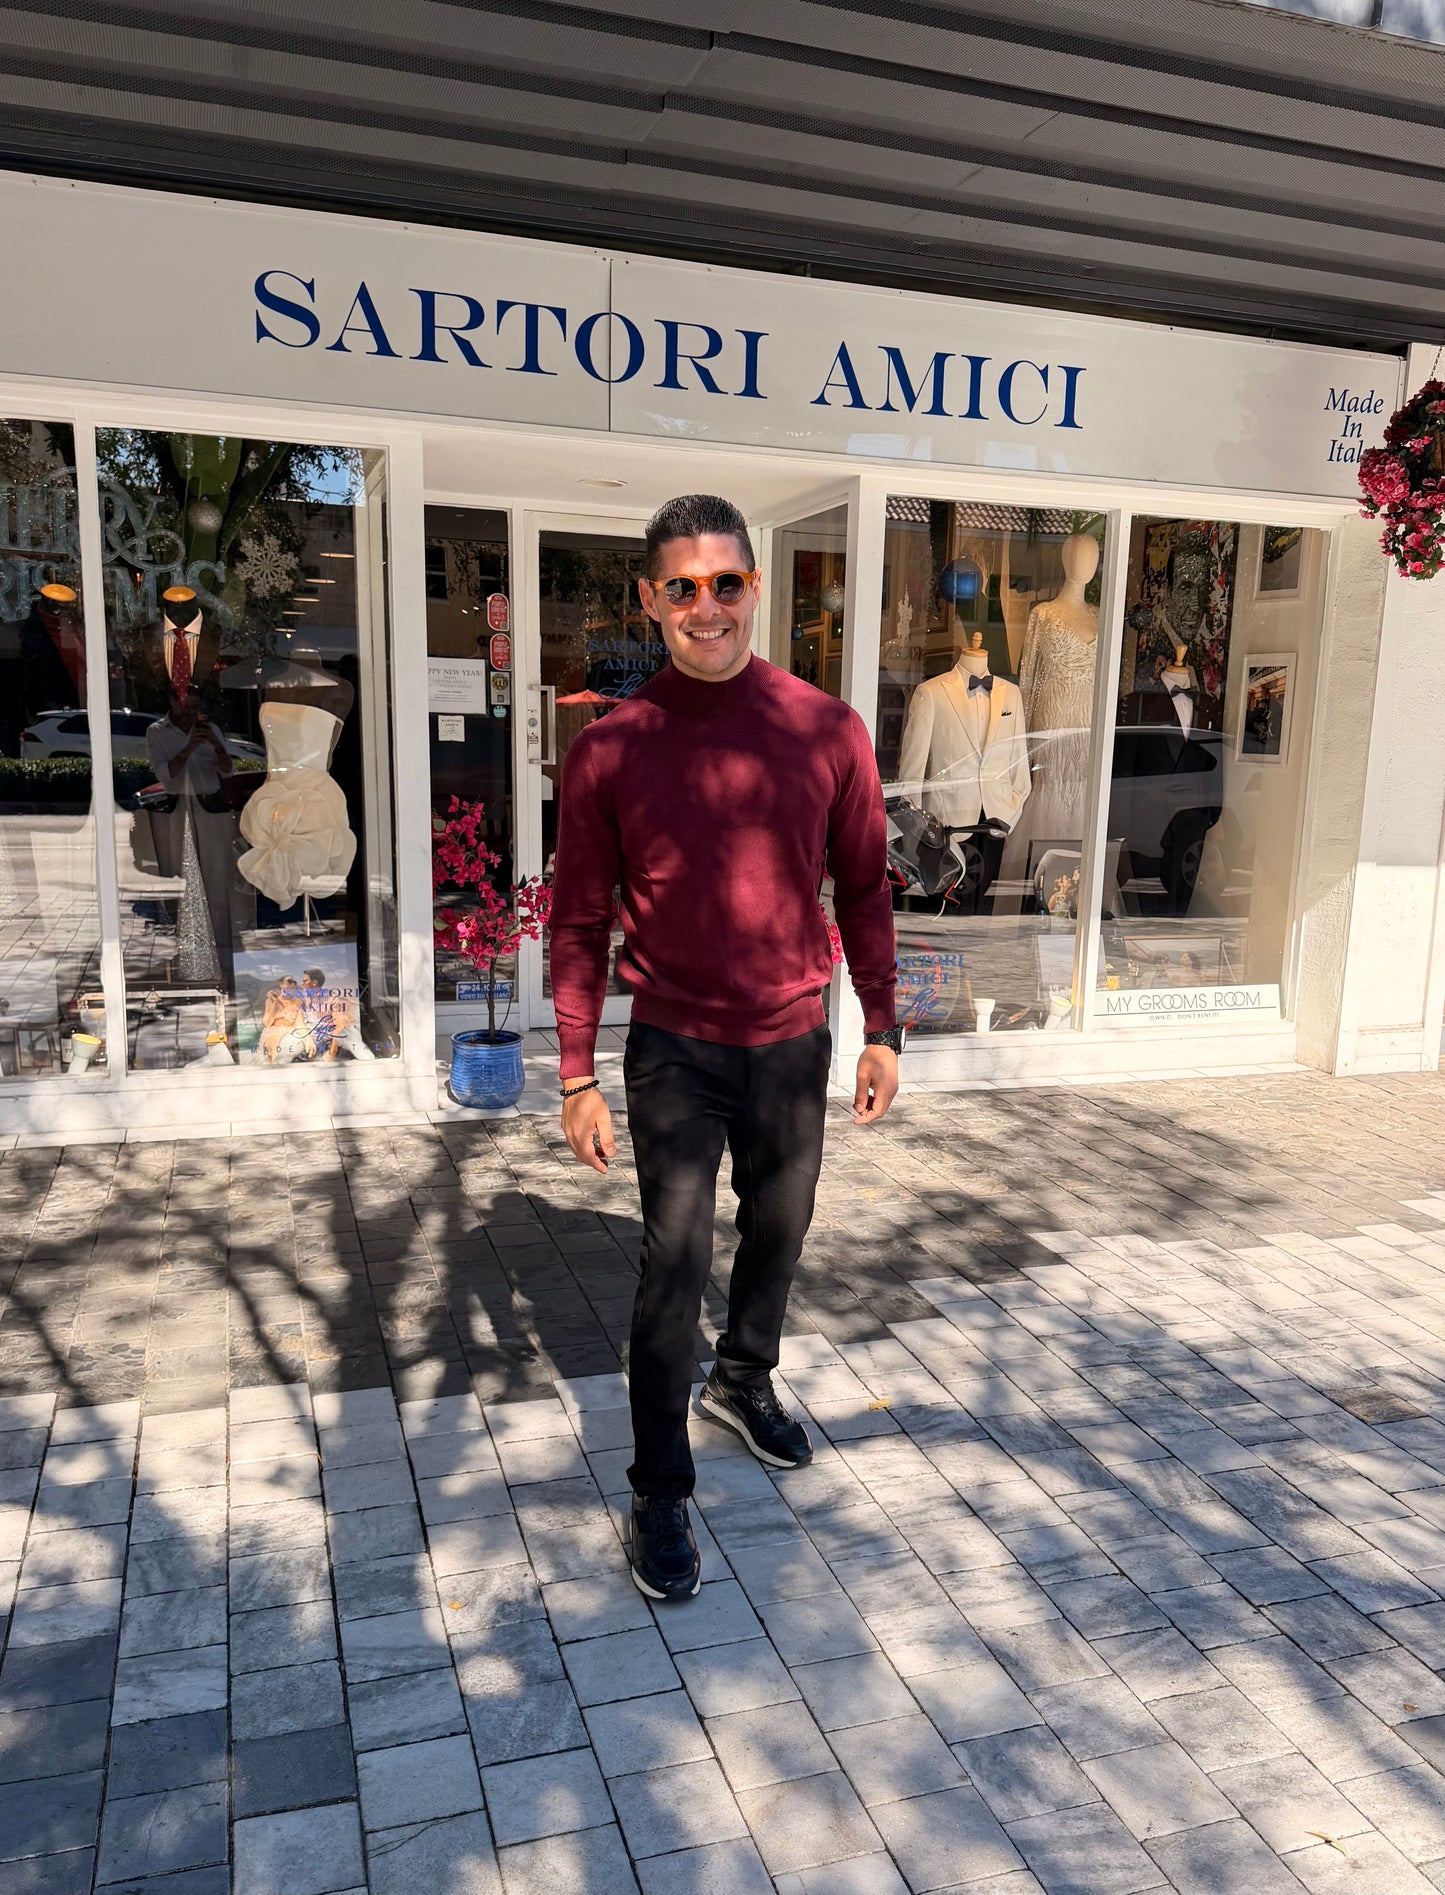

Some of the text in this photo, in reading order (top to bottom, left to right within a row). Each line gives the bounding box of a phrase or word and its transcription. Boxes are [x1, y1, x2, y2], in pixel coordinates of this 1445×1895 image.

[254, 270, 1088, 430] SARTORI AMICI
[1323, 387, 1385, 415] Made
[1340, 414, 1363, 438] In
[1326, 439, 1364, 463] Ital
[443, 668, 459, 676] NEW
[604, 659, 657, 672] AMICI
[896, 953, 964, 968] ARTORI
[282, 987, 360, 999] SARTORI
[299, 1002, 347, 1013] AMICI
[1105, 991, 1261, 1013] MY GROOMS ROOM
[251, 1045, 294, 1055] MADE
